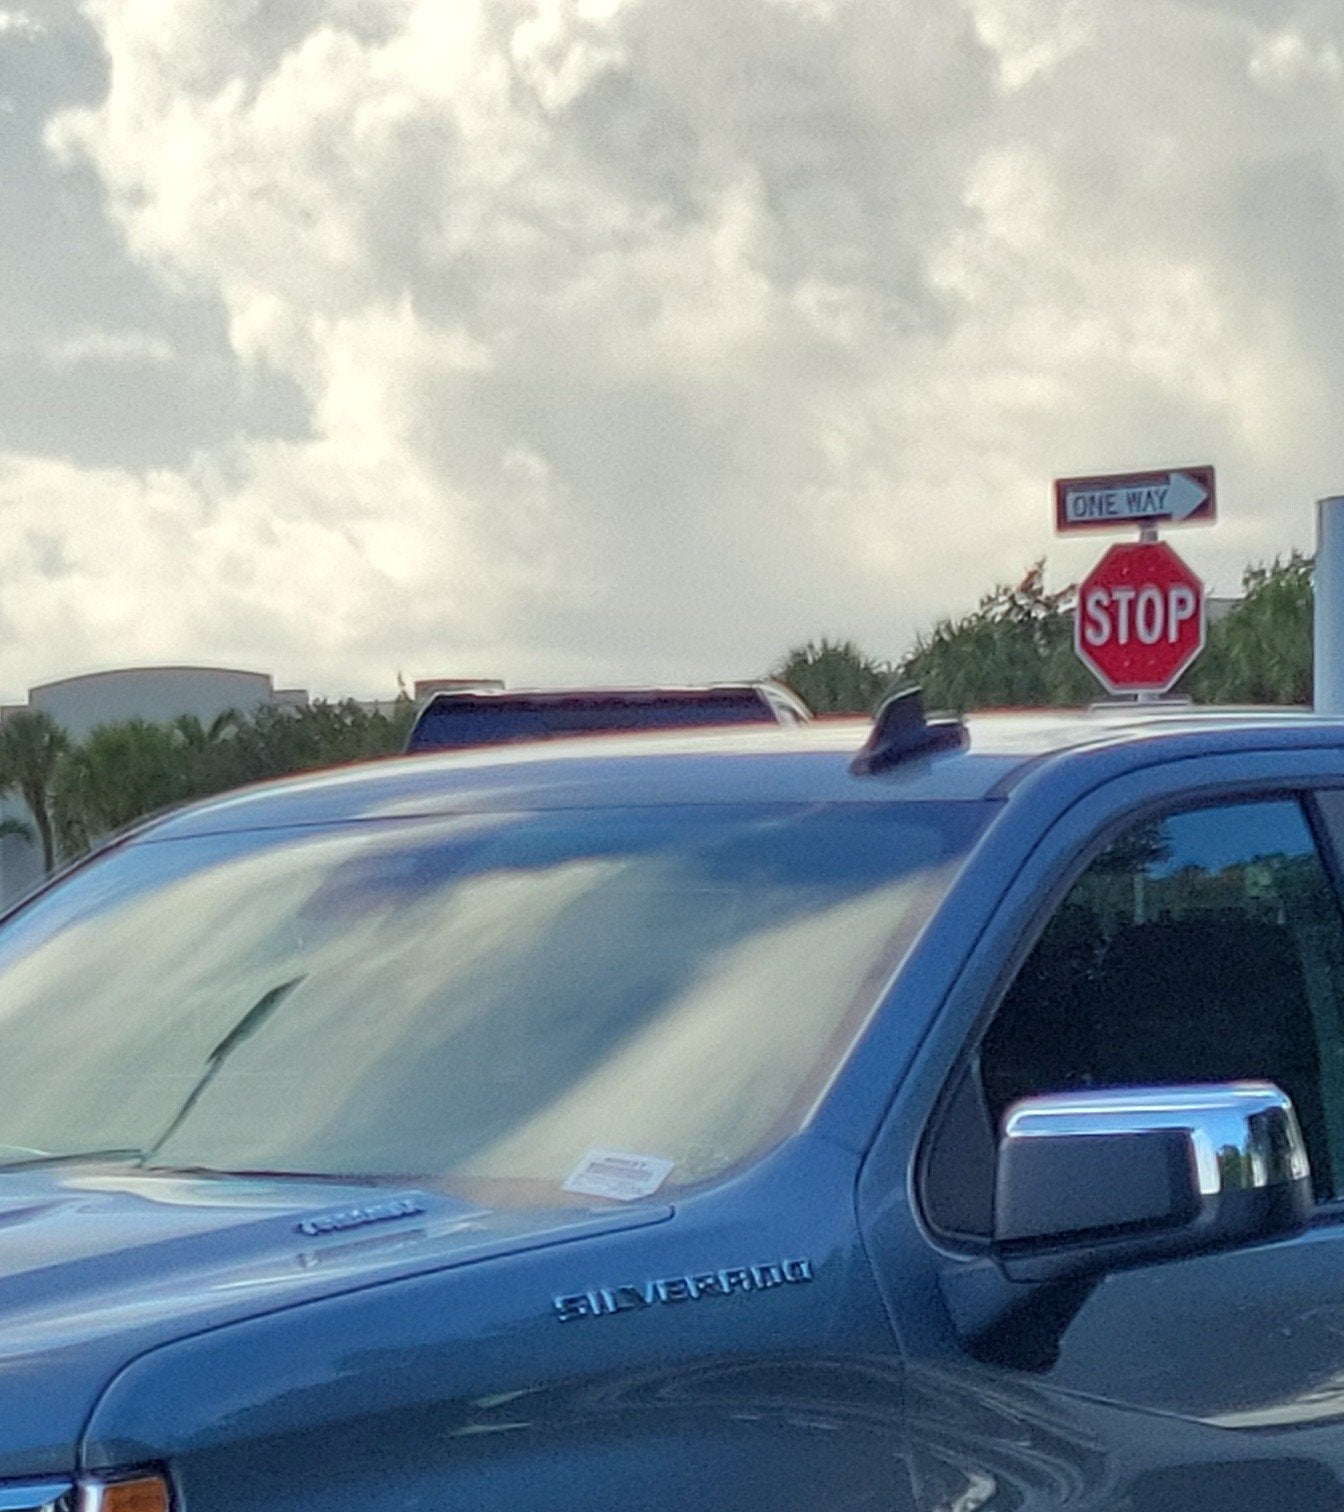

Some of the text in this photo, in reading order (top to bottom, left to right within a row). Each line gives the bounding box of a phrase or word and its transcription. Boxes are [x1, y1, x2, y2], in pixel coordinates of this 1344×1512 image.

[1072, 487, 1169, 518] ONE WAY
[1084, 585, 1196, 647] STOP
[553, 1257, 814, 1323] SILVERADO
